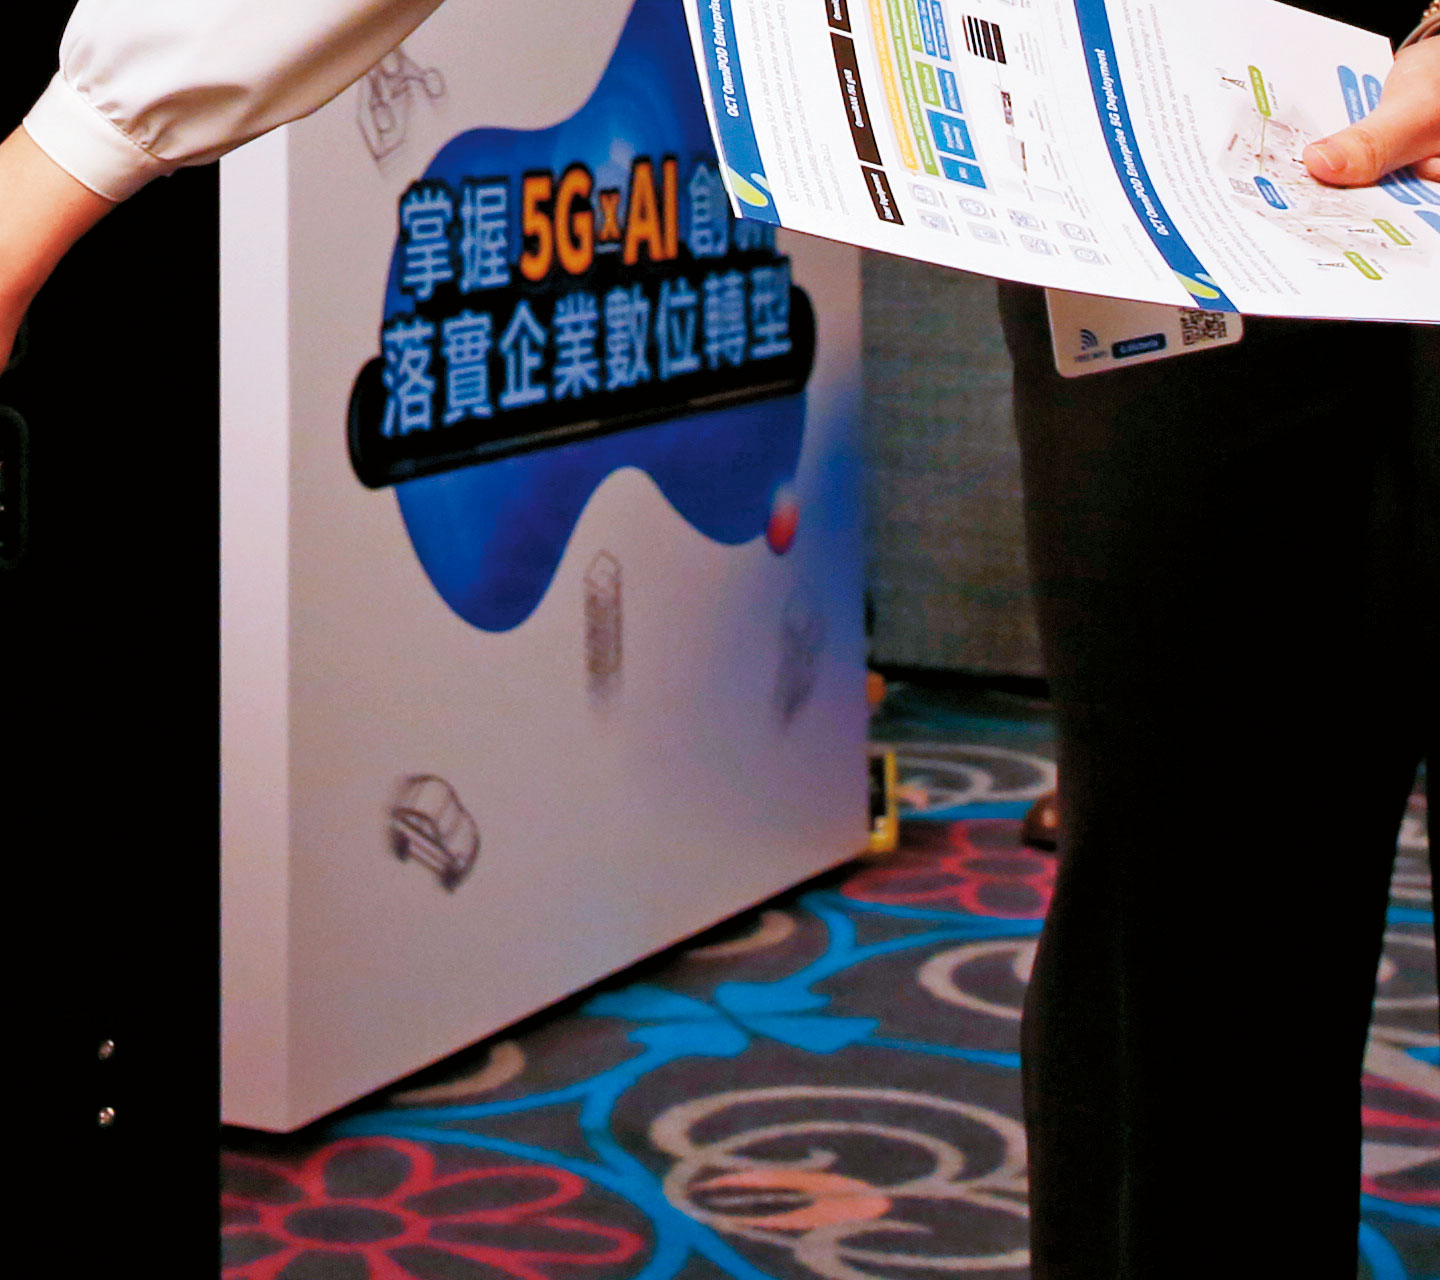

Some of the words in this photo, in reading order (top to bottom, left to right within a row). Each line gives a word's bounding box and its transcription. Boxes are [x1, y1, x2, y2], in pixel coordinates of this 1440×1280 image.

[716, 46, 736, 95] OmniPOD
[1093, 46, 1119, 115] Deployment
[724, 95, 740, 118] QCT
[1109, 113, 1124, 128] 5G
[1115, 127, 1139, 177] Enterprise
[1149, 217, 1169, 238] QCT
[381, 260, 793, 438] 落實企業數位轉型
